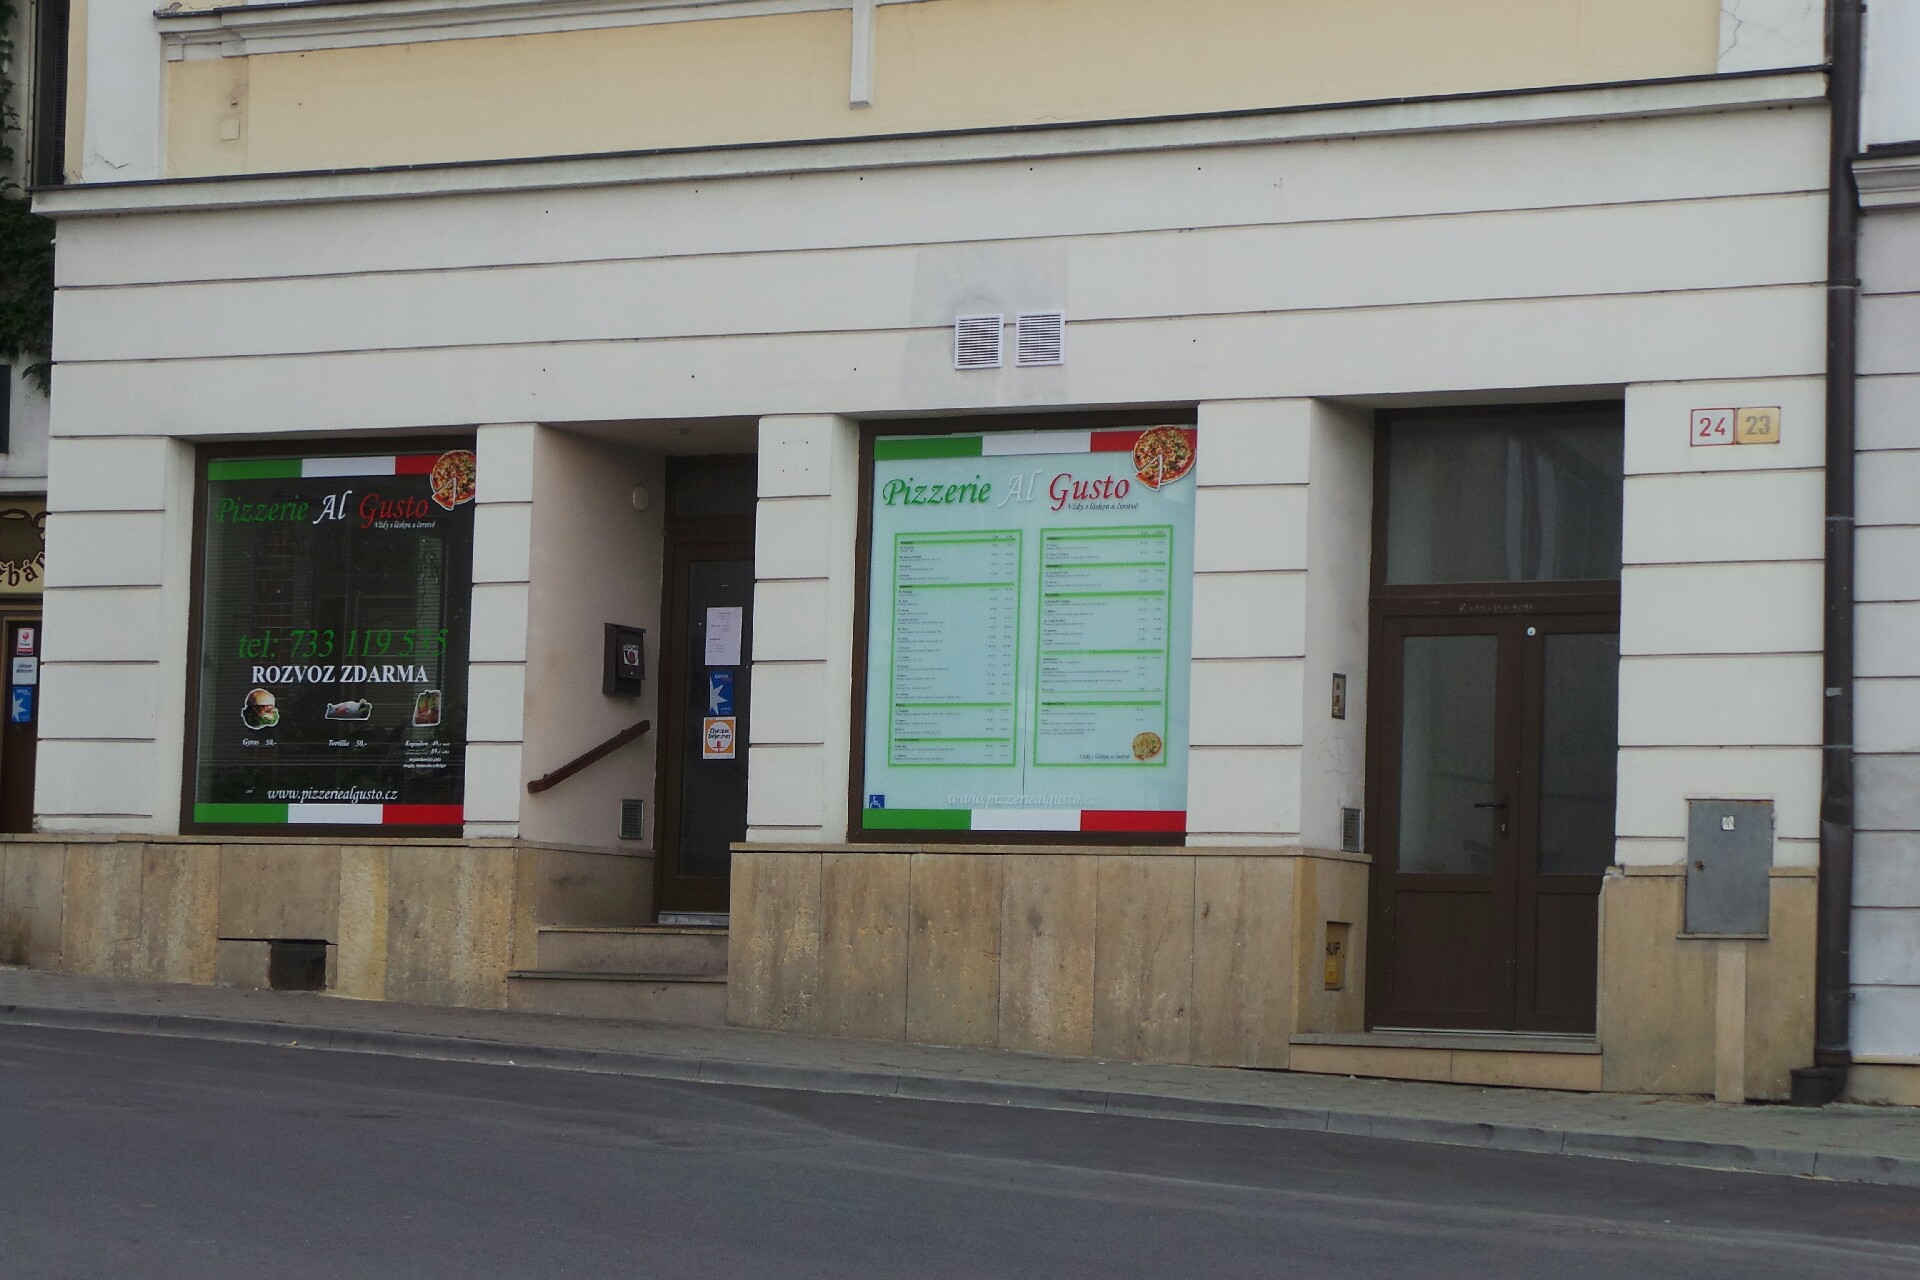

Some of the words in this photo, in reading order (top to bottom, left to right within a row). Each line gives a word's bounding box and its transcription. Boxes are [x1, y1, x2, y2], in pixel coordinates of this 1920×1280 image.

[1699, 416, 1726, 437] 24
[1745, 415, 1771, 436] 23
[882, 474, 991, 506] Pizzerie
[997, 470, 1043, 508] Al
[1049, 473, 1131, 511] Gusto
[215, 494, 309, 524] Pizzerie
[312, 489, 352, 525] Al
[359, 493, 430, 529] Gusto
[238, 628, 280, 659] tel:
[290, 628, 335, 658] 733
[346, 628, 393, 658] 119
[251, 665, 336, 684] ROZVOZ
[339, 665, 430, 683] ZDARMA
[328, 739, 350, 747] Tortilla
[267, 785, 398, 804] www.pizzeriealgusto.cz
